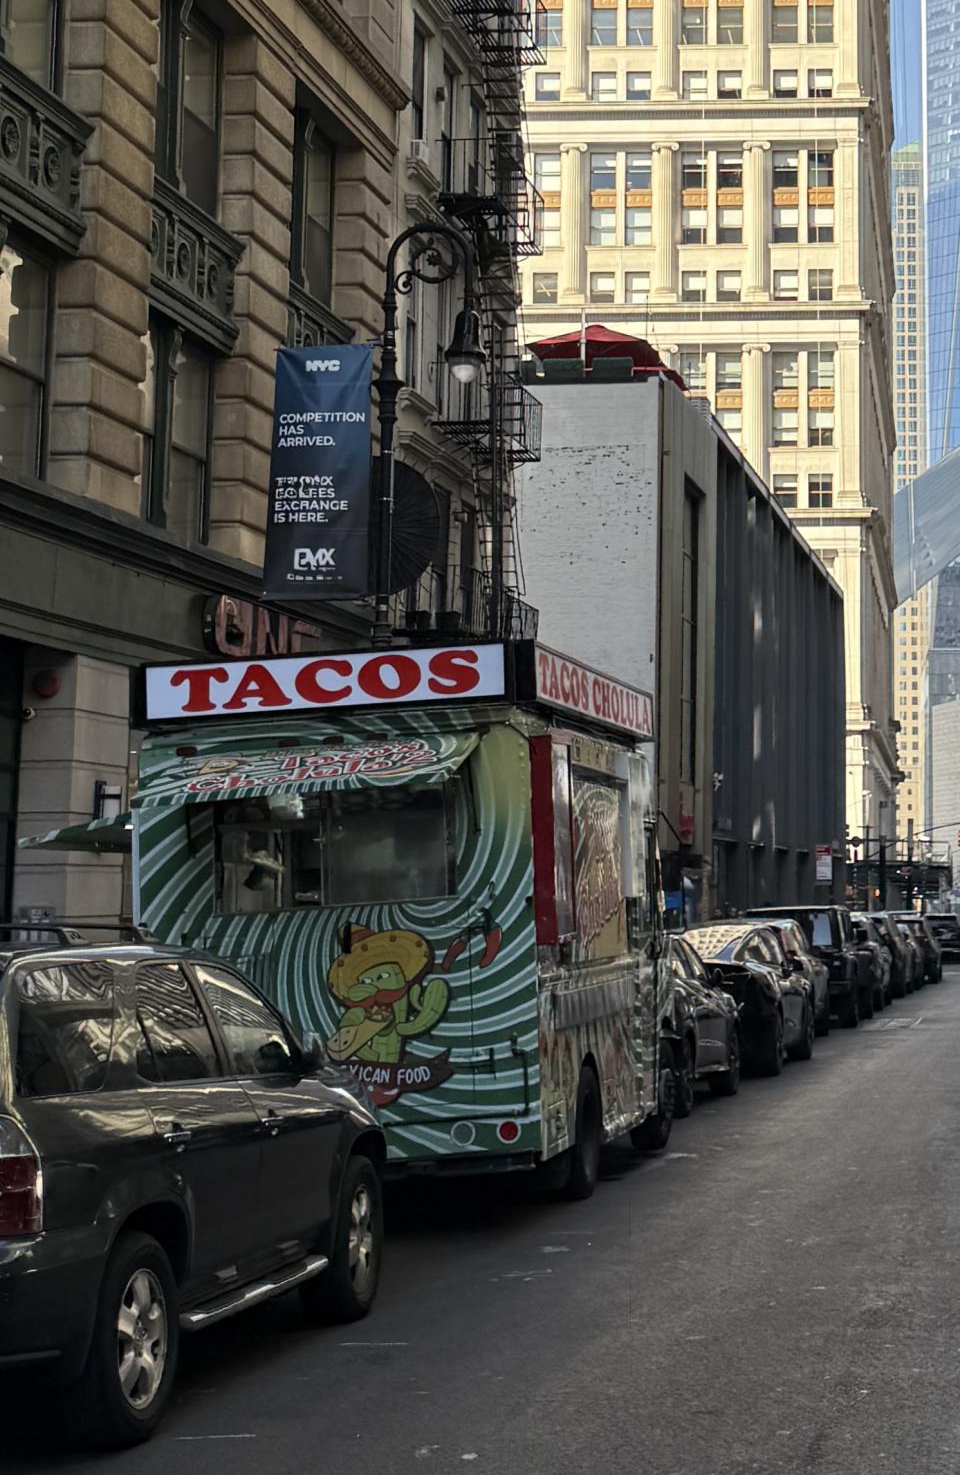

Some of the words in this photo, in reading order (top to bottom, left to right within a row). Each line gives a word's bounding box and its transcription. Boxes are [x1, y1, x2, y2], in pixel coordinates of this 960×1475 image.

[306, 359, 340, 372] NYC
[280, 412, 365, 424] COMPETITION
[279, 425, 304, 436] HAS
[278, 436, 336, 447] ARRIVED.
[274, 513, 286, 523] IS
[288, 512, 328, 523] HERE.
[170, 649, 480, 713] TACOS
[538, 652, 590, 711] TACOS
[592, 677, 651, 734] CHOLULA
[396, 1066, 431, 1085] FOOD
